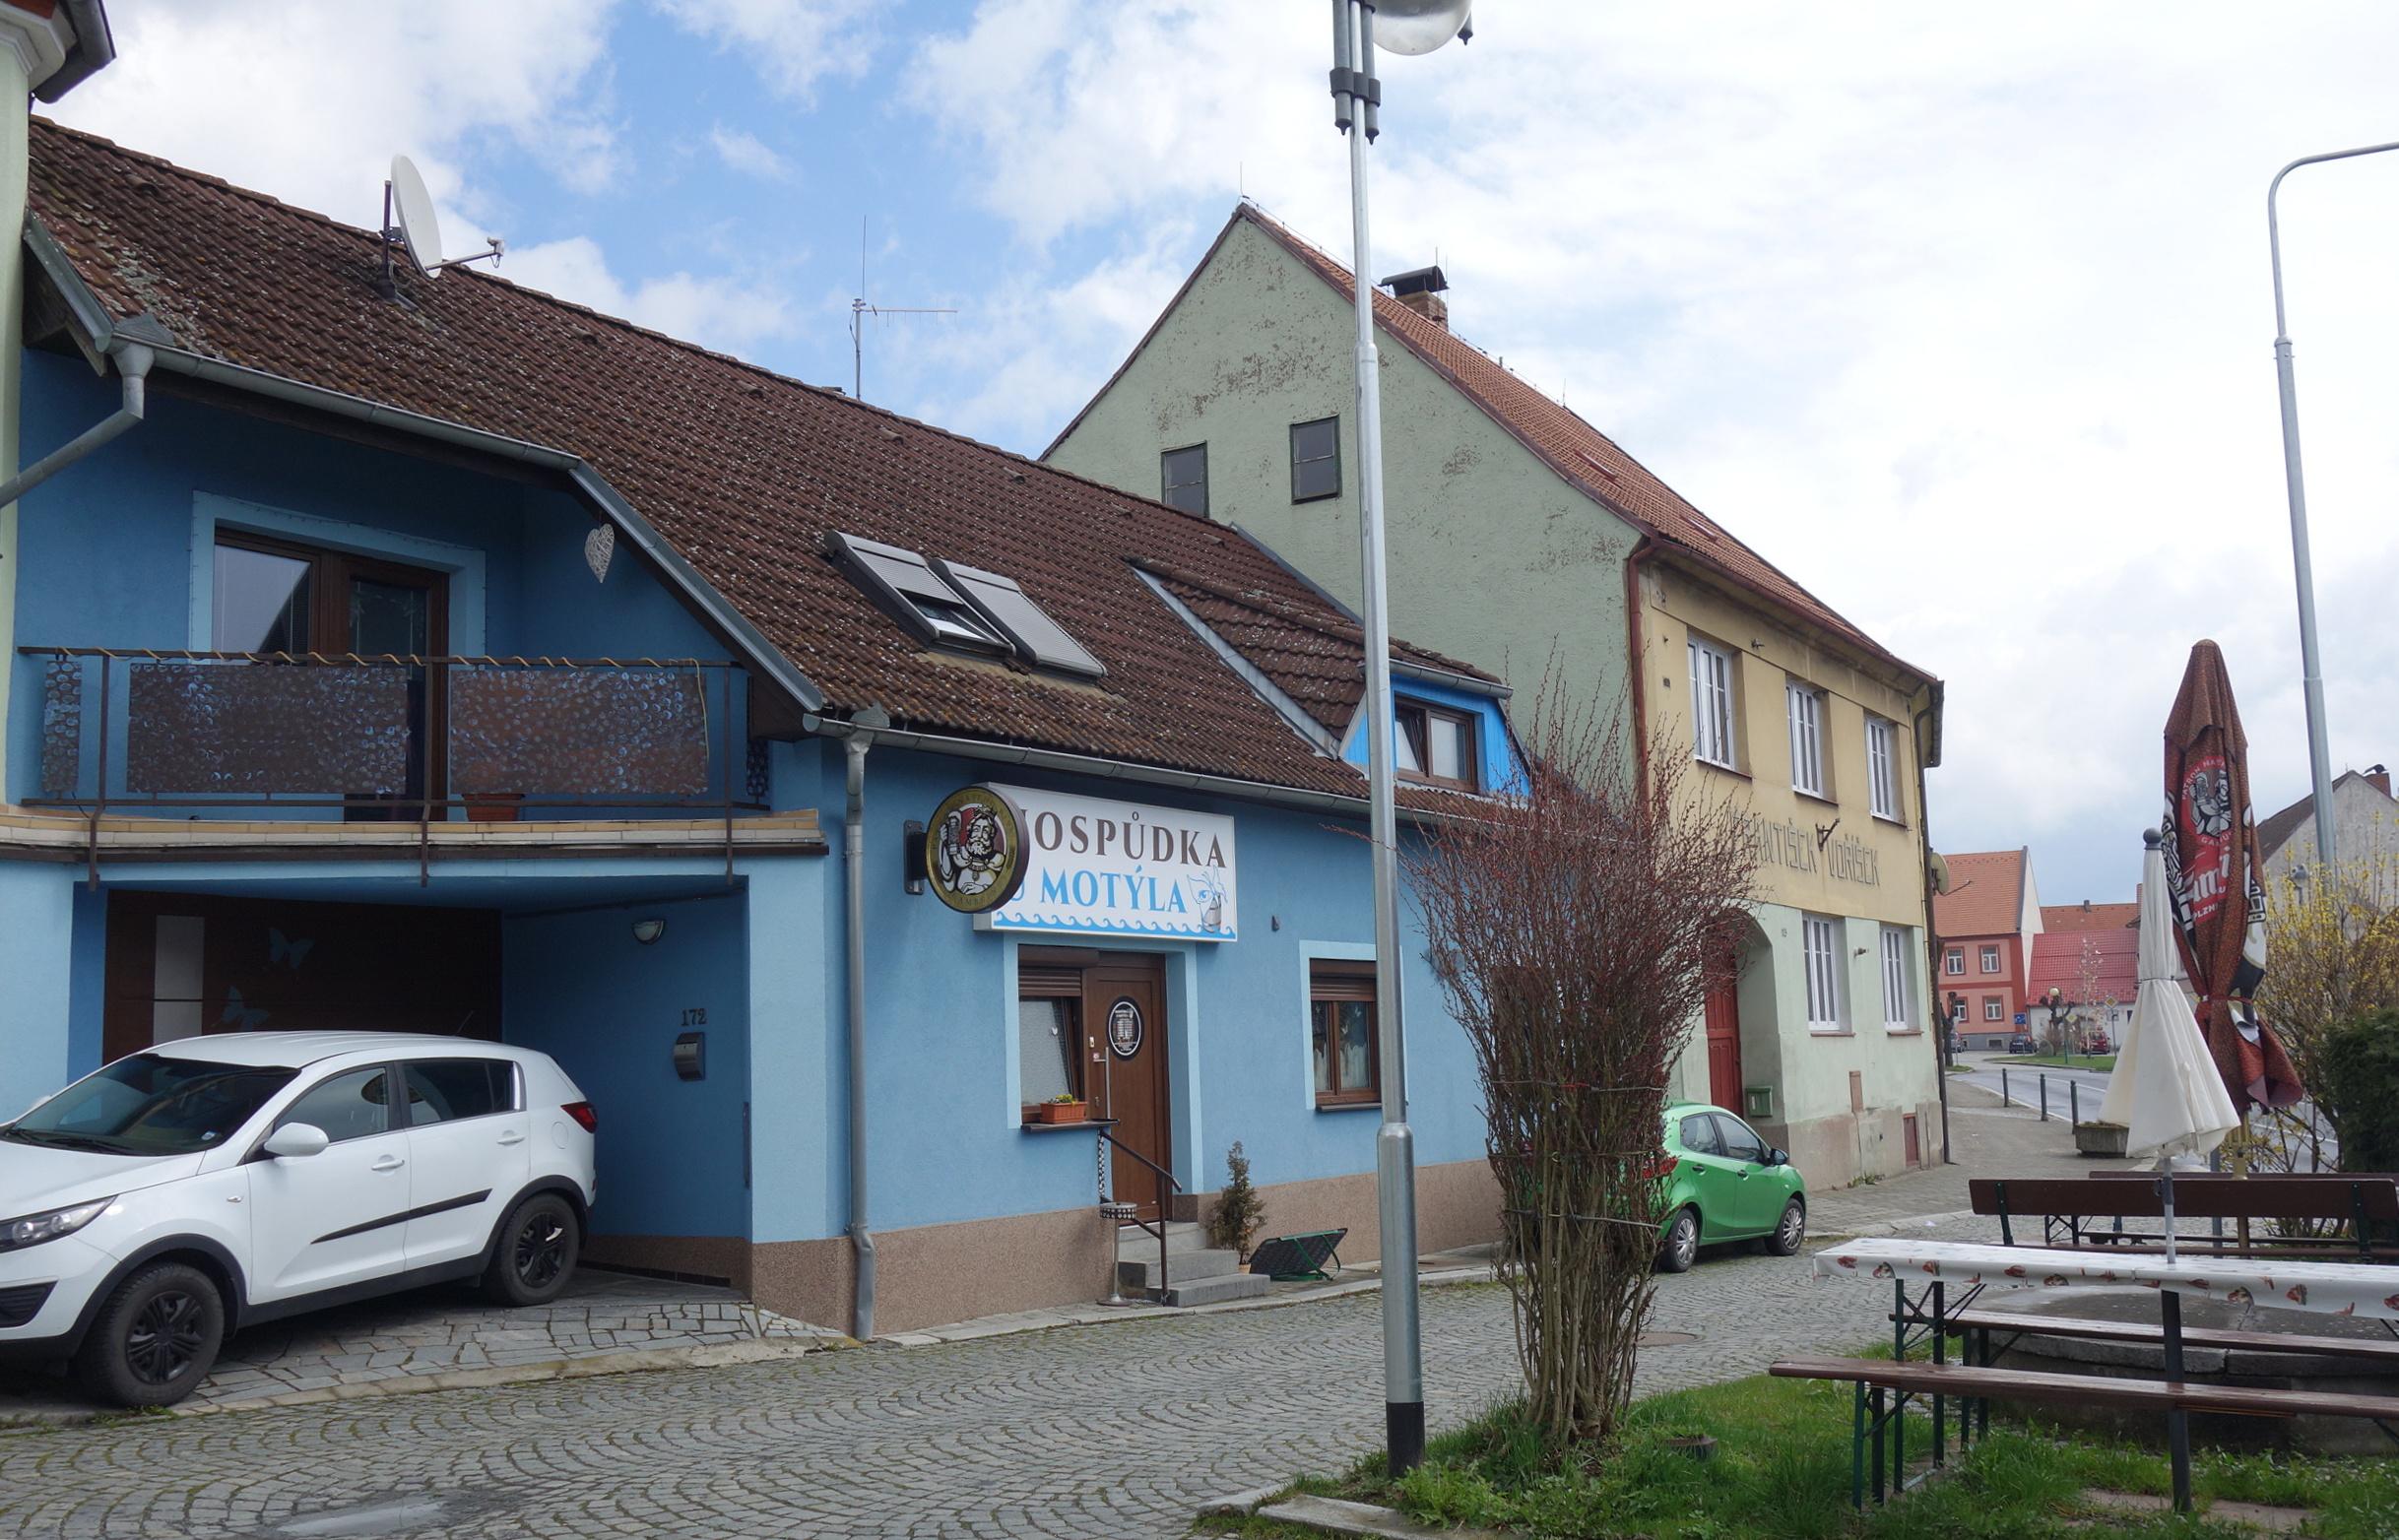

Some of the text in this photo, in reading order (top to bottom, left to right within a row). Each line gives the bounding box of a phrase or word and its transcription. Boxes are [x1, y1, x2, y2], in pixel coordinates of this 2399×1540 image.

[1021, 809, 1227, 868] OSPŮDKA
[1040, 865, 1188, 914] MOTÝLA
[681, 1008, 707, 1026] 172
